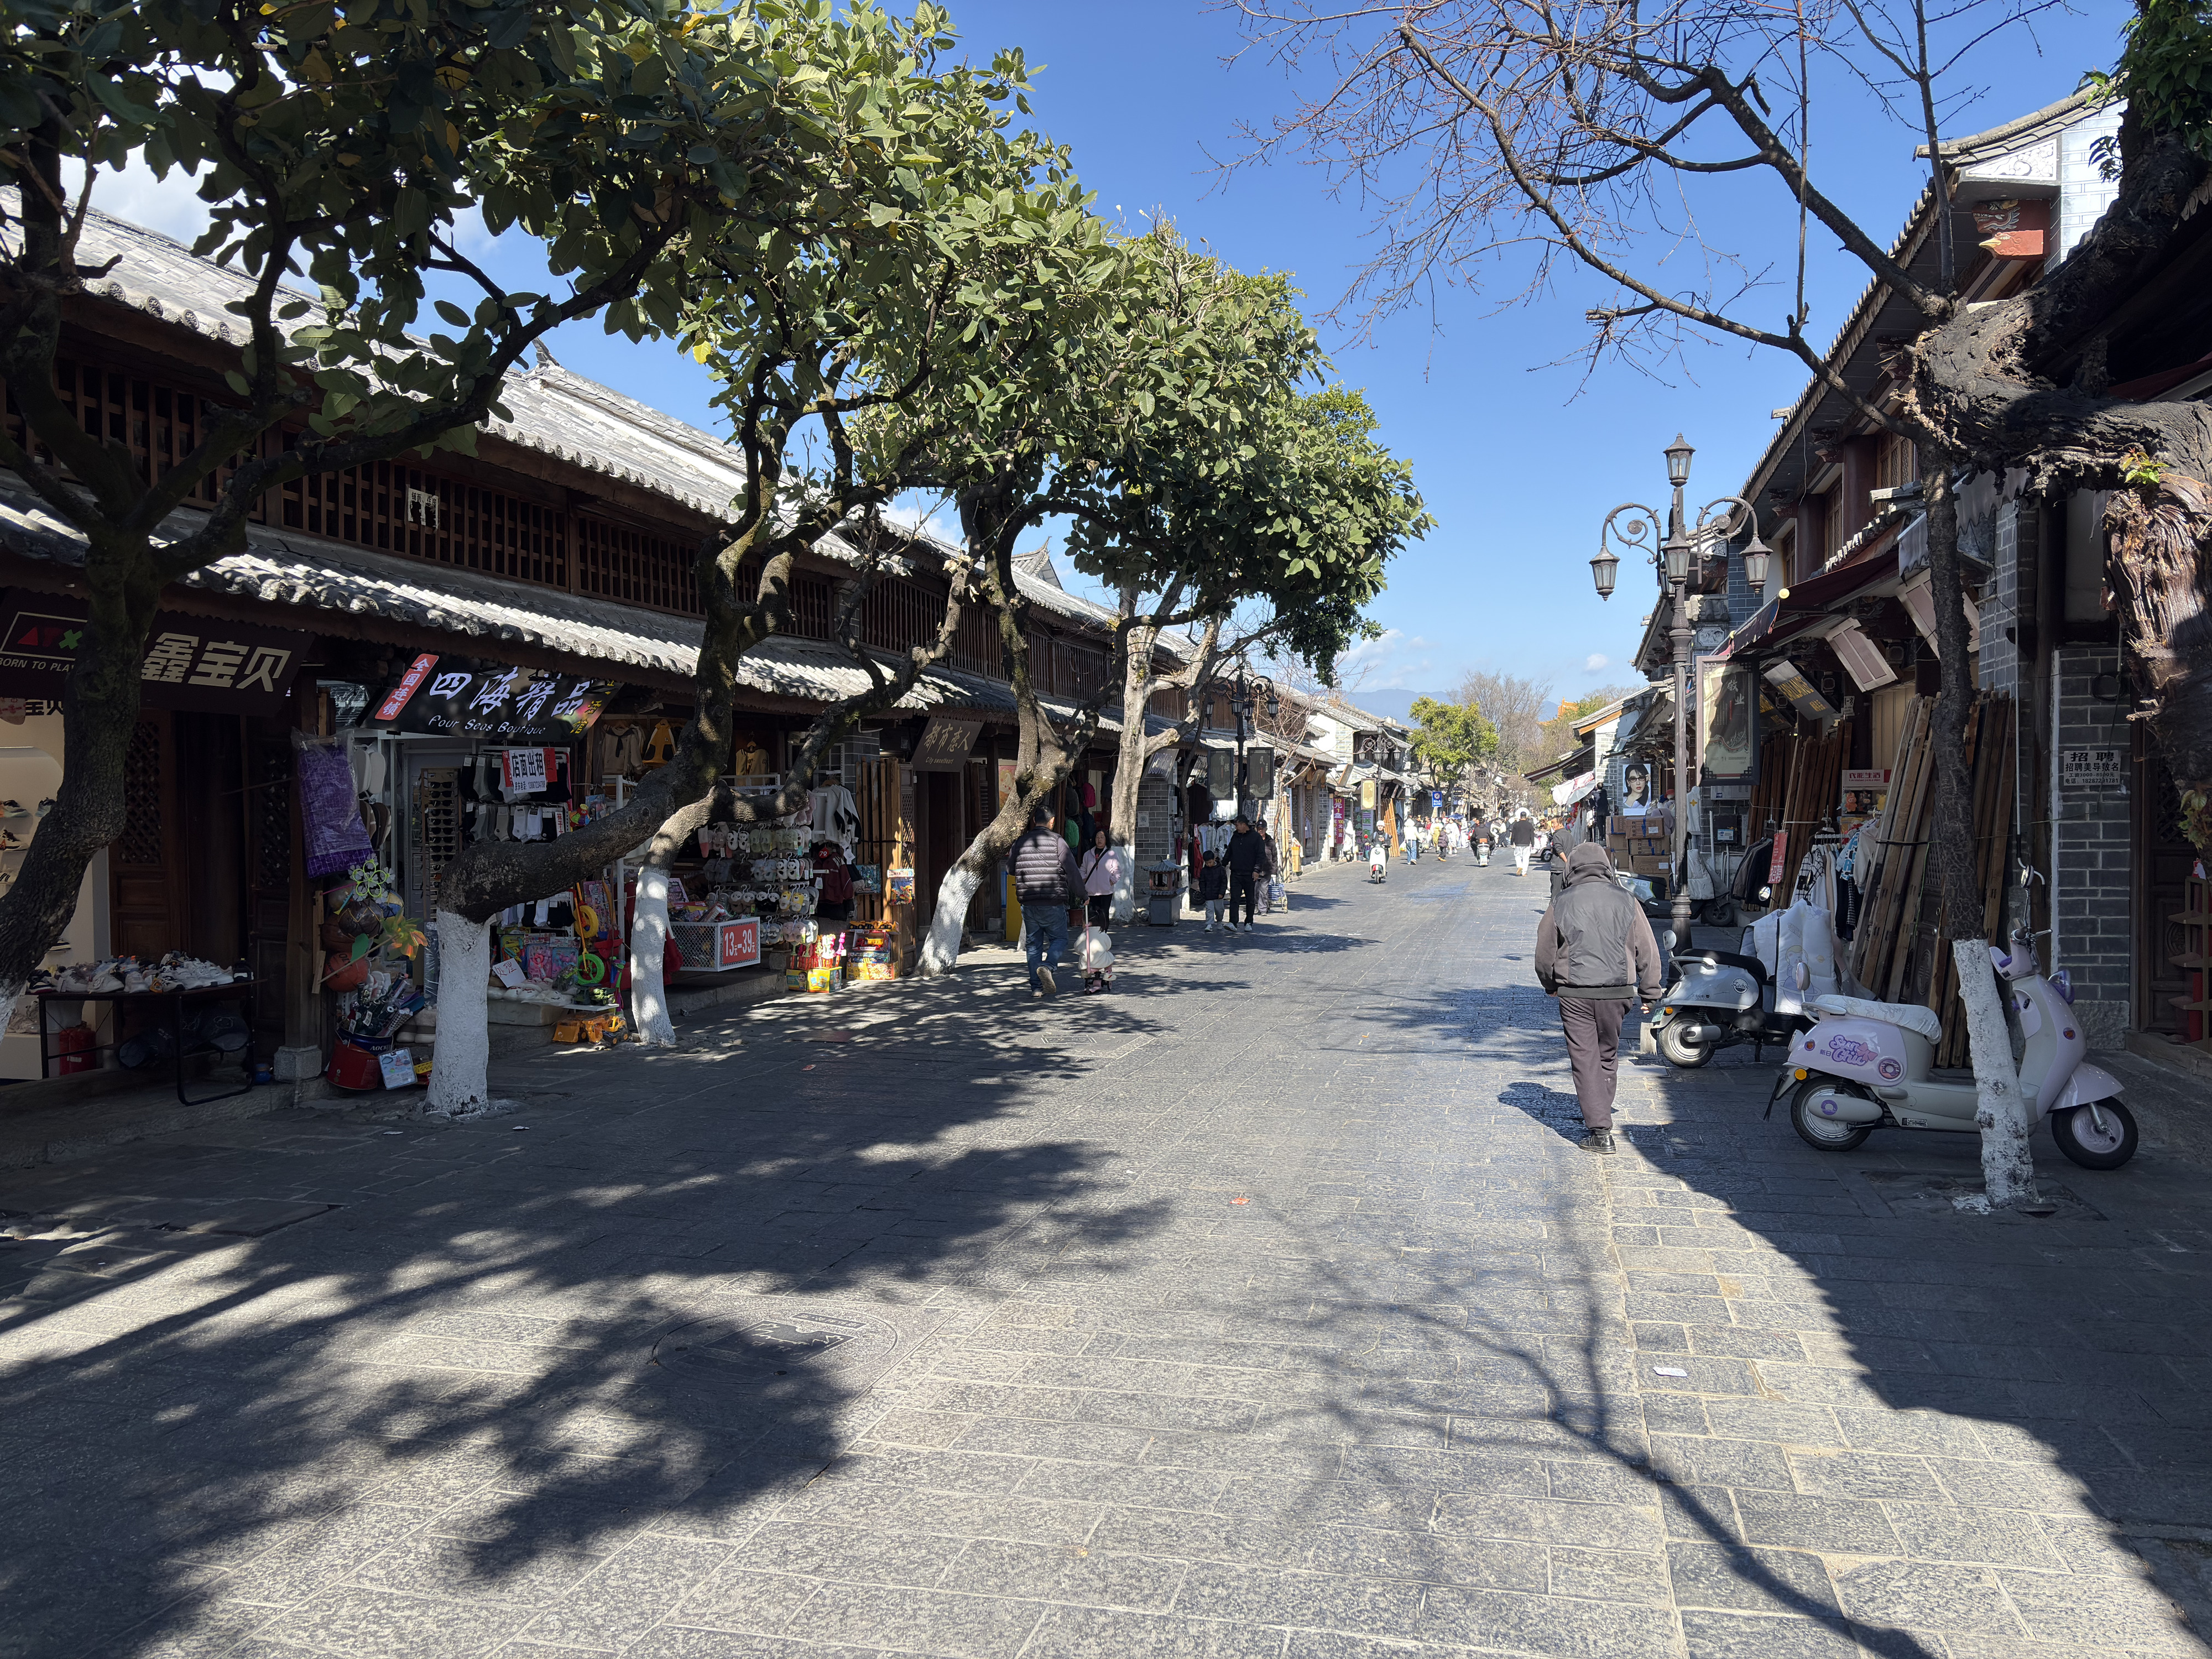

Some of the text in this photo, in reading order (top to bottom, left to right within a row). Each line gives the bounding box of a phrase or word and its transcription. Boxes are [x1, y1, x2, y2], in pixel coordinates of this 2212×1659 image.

[31, 661, 46, 670] TO
[142, 632, 291, 692] 鑫宝贝
[383, 658, 429, 716] 全国连锁
[430, 666, 594, 721] 四海精品
[1727, 679, 1745, 706] 敬业
[428, 715, 546, 734] Four Seas Boutique
[511, 752, 545, 778] 店面出租
[1259, 755, 1269, 773] 民主
[2065, 762, 2119, 771] 招聘美导数名
[2070, 752, 2115, 762] 招聘
[1768, 864, 1783, 883] 招聘
[1829, 1035, 1861, 1051] Sun
